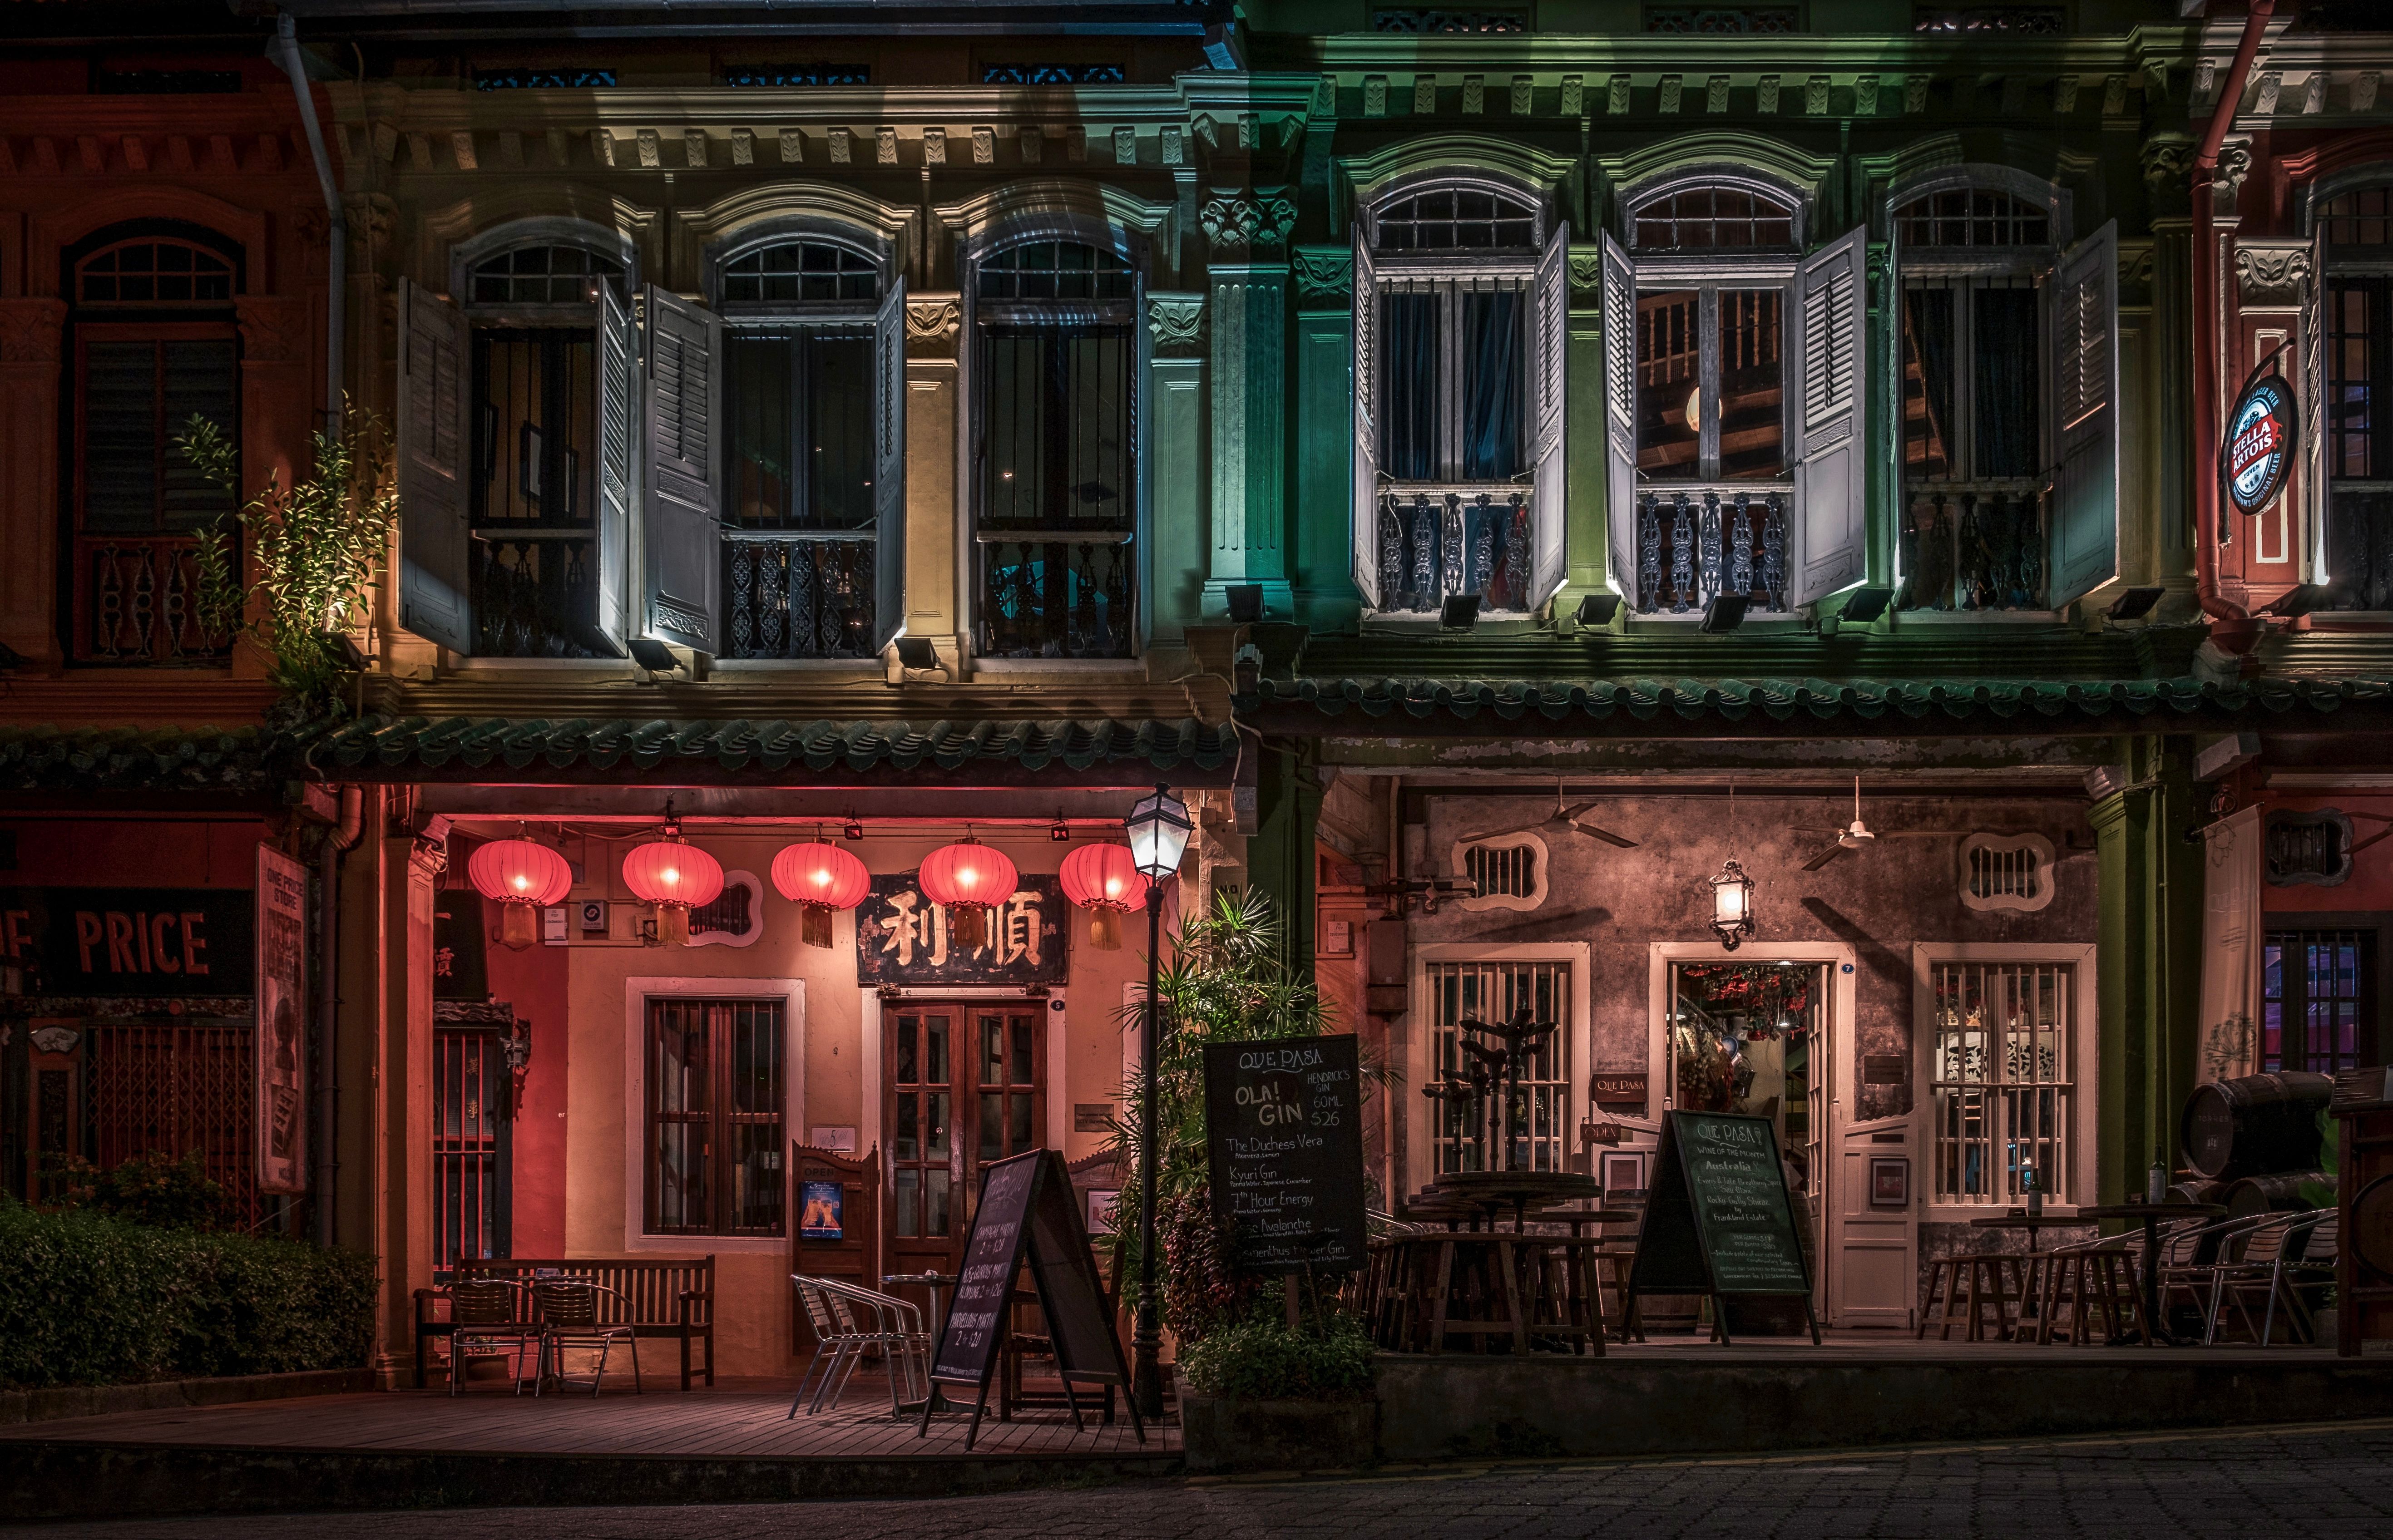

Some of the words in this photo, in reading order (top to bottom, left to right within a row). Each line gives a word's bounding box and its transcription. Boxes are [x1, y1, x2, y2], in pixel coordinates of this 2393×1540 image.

[2233, 421, 2271, 459] STELLA
[2234, 433, 2272, 473] ARTOIS
[2270, 453, 2281, 474] BEER
[267, 868, 282, 887] ONE
[283, 875, 303, 897] PRICE
[274, 888, 297, 910] STORE
[74, 910, 210, 976] PRICE
[1240, 1051, 1276, 1069] QUE
[1279, 1049, 1323, 1067] PASA
[1307, 1070, 1350, 1084] HENDRICK'S
[1317, 1084, 1330, 1093] GIN
[1597, 1081, 1617, 1091] QUE
[1620, 1081, 1645, 1090] PASA
[1314, 1096, 1343, 1108] 60ML
[1259, 1103, 1302, 1125] GIN
[1311, 1111, 1340, 1126] $26
[1585, 1127, 1616, 1138] OPEN
[1697, 1124, 1720, 1142] QUE
[1722, 1125, 1755, 1143] PASA
[1226, 1139, 1247, 1151] The
[1250, 1136, 1295, 1152] Duchess
[1297, 1134, 1323, 1148] Vera
[1740, 1150, 1765, 1159] MONTH
[804, 1168, 834, 1177] OPEN
[1230, 1166, 1257, 1182] Kyuri
[1260, 1164, 1277, 1179] Gin
[1706, 1160, 1751, 1171] Australia
[1251, 1192, 1277, 1208] Hour
[1280, 1191, 1313, 1207] Energy
[1261, 1218, 1312, 1233] Avalanche
[979, 1241, 986, 1255] 2
[1328, 1240, 1345, 1254] Gin
[955, 1331, 962, 1346] 2
